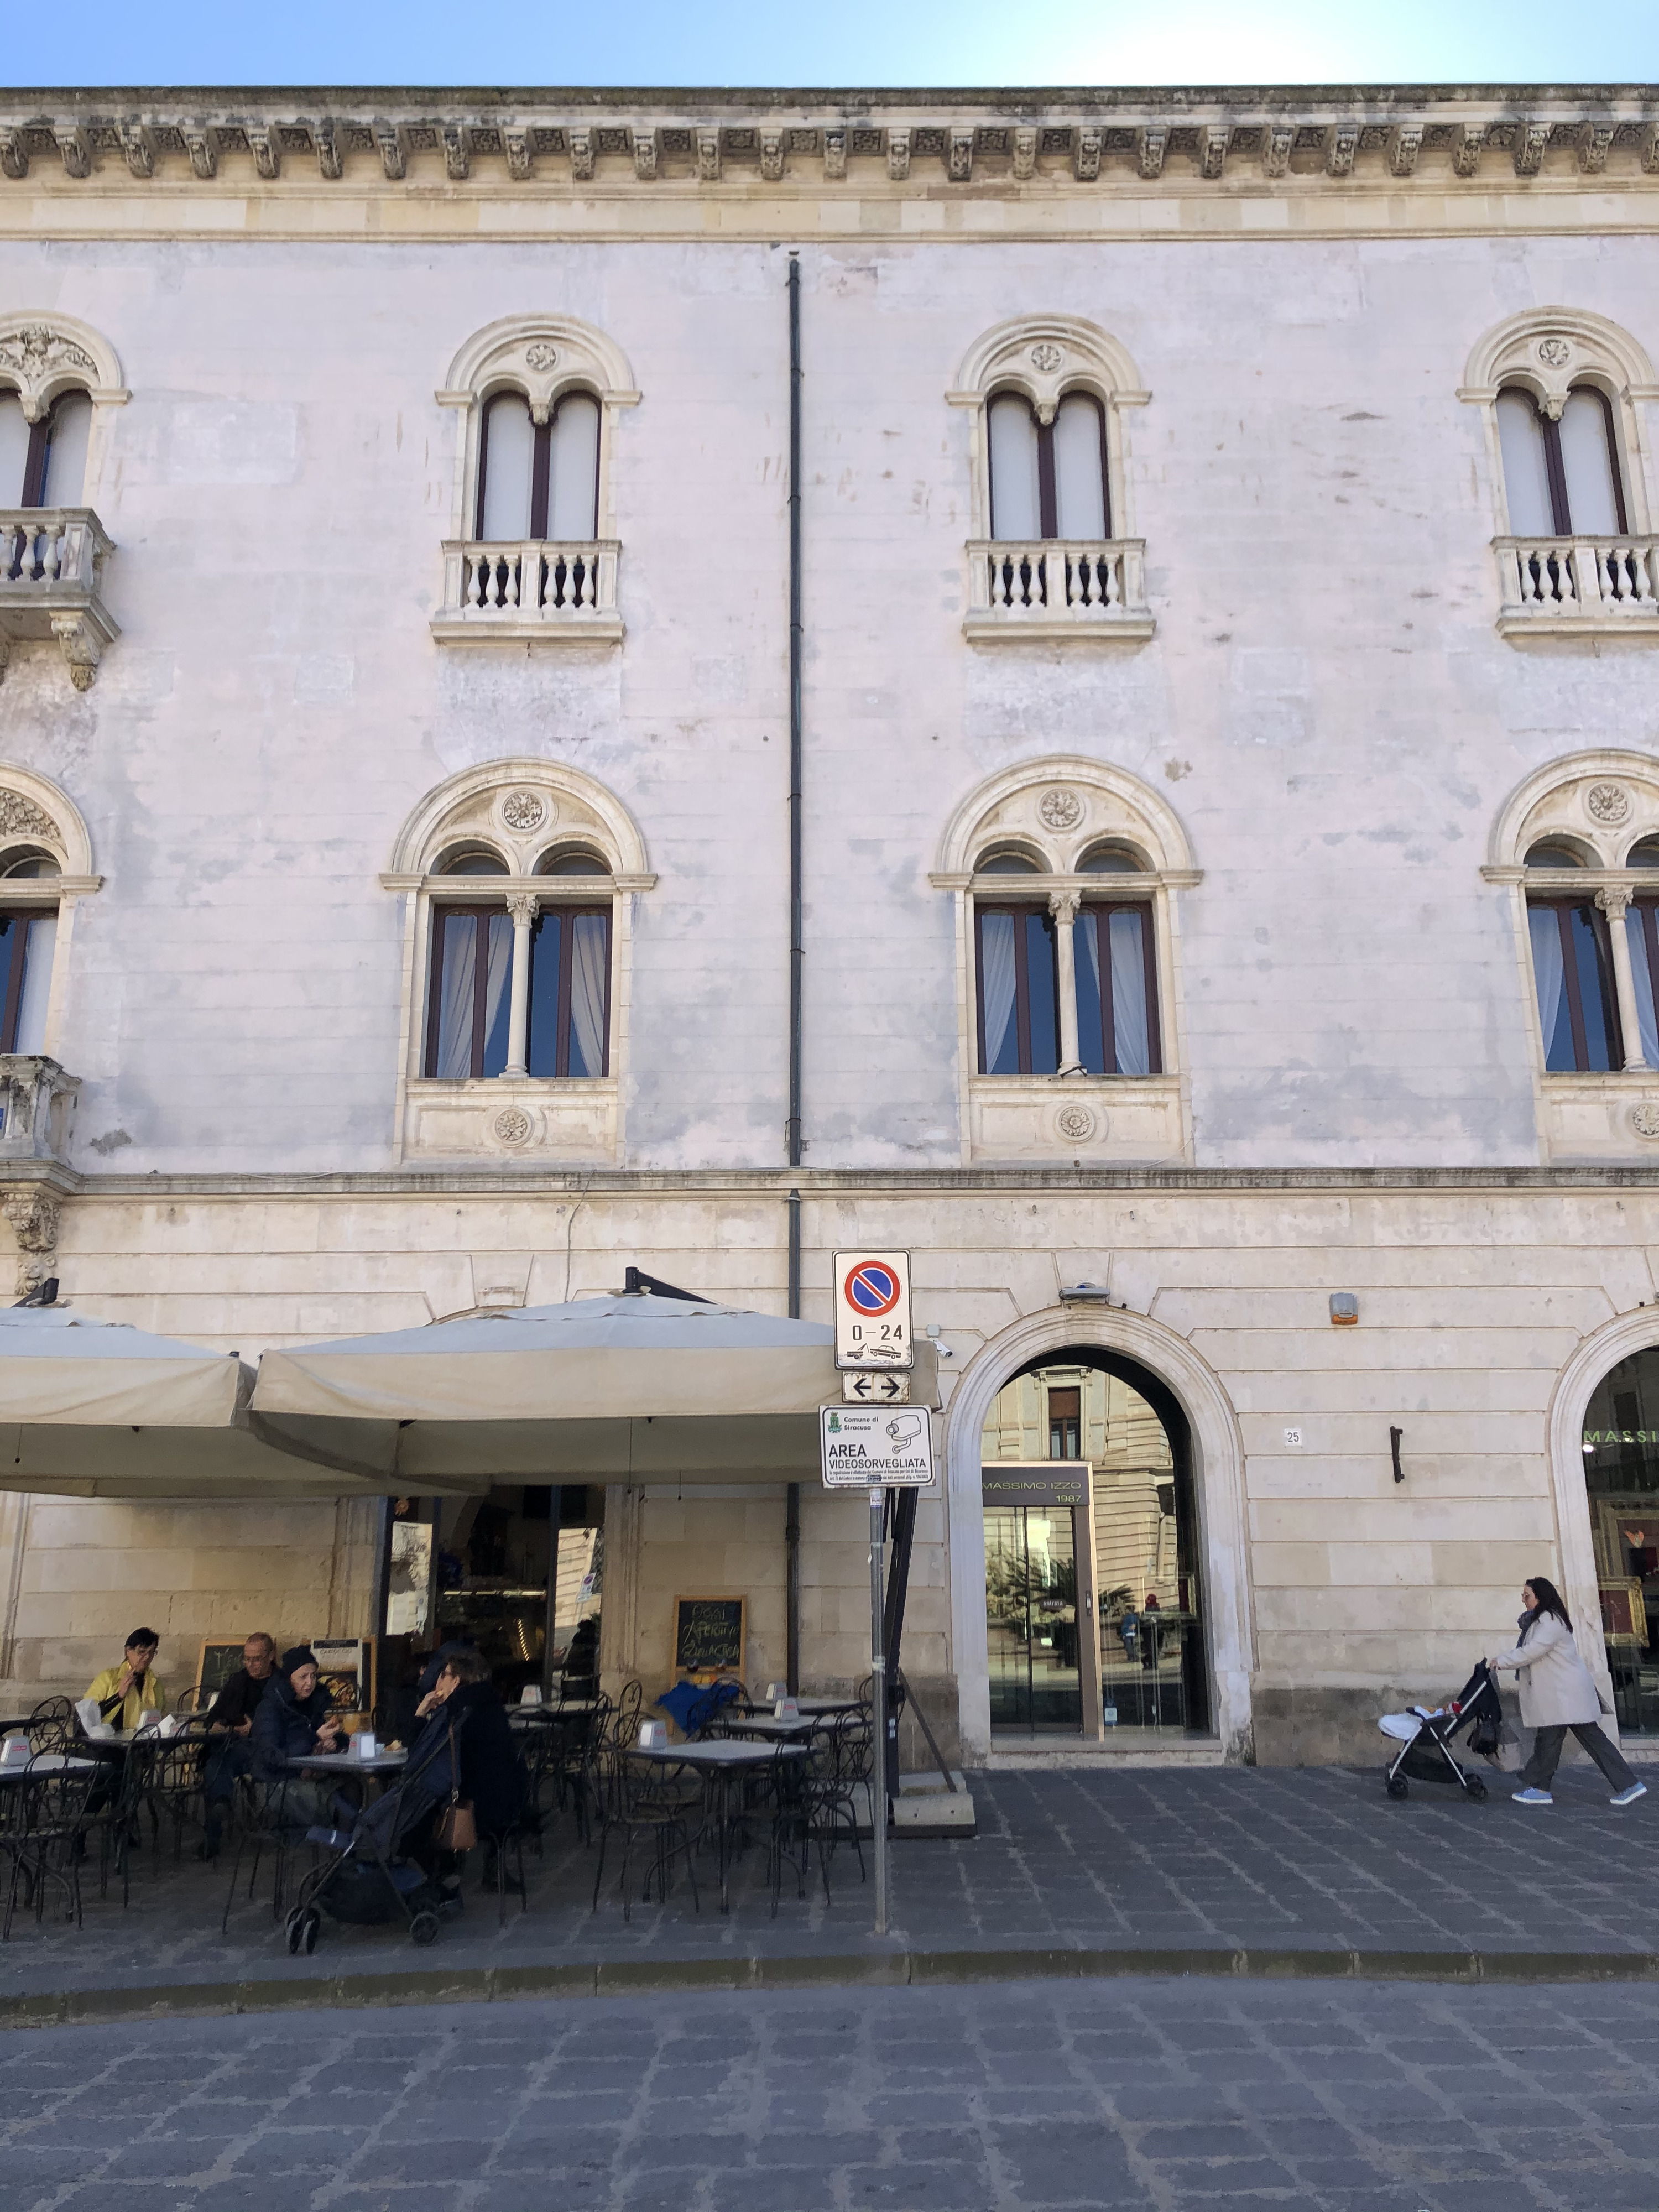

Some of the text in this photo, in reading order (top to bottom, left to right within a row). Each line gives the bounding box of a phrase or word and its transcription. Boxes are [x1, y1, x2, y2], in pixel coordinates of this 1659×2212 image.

[880, 1324, 902, 1340] 24
[1287, 1432, 1300, 1442] 25
[828, 1444, 867, 1457] AREA
[829, 1458, 926, 1469] VIDEOSORVEGLIATA
